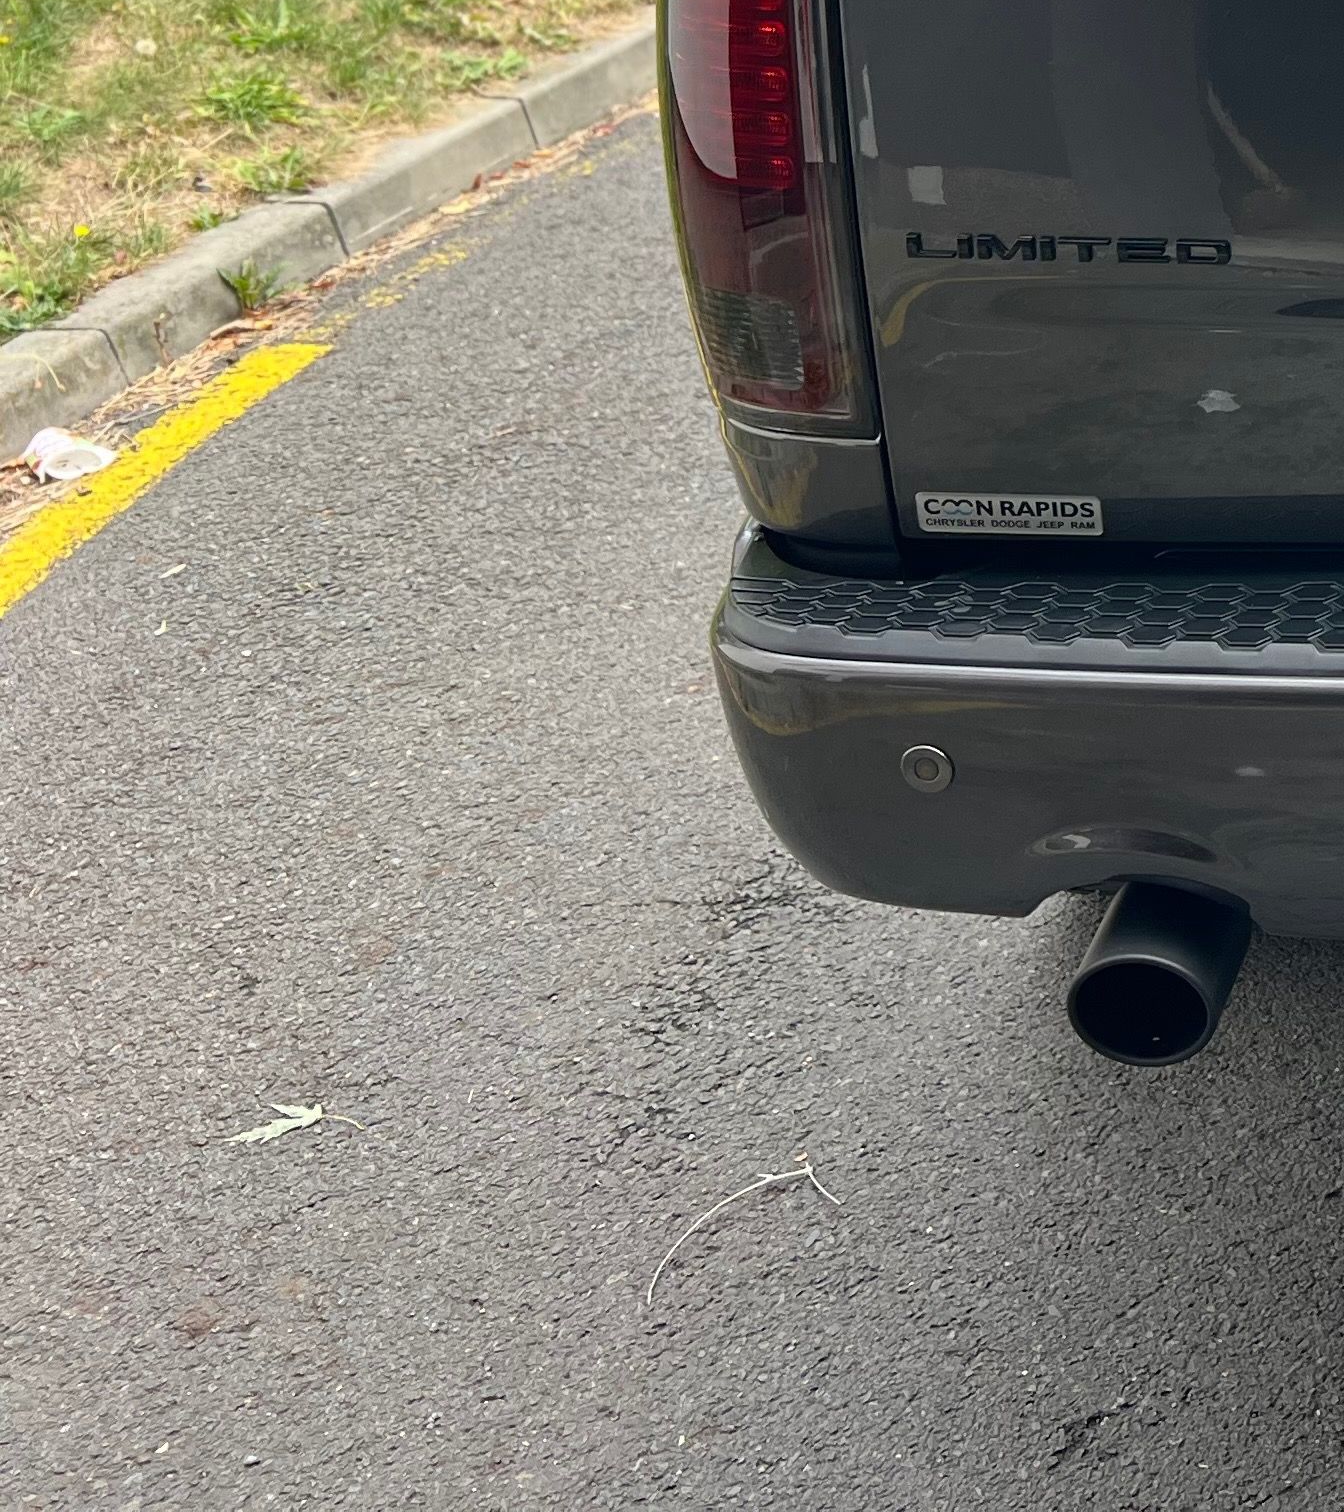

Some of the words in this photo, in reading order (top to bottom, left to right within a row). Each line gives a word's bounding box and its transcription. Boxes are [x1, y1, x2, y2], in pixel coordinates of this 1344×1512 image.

[905, 232, 1232, 265] LIMITED
[923, 498, 993, 517] COON
[1000, 500, 1095, 518] RAPIDS
[925, 518, 985, 528] CHRYSLER
[991, 519, 1031, 528] DODGE
[1036, 520, 1064, 529] JEEP
[1070, 521, 1096, 529] RAM
